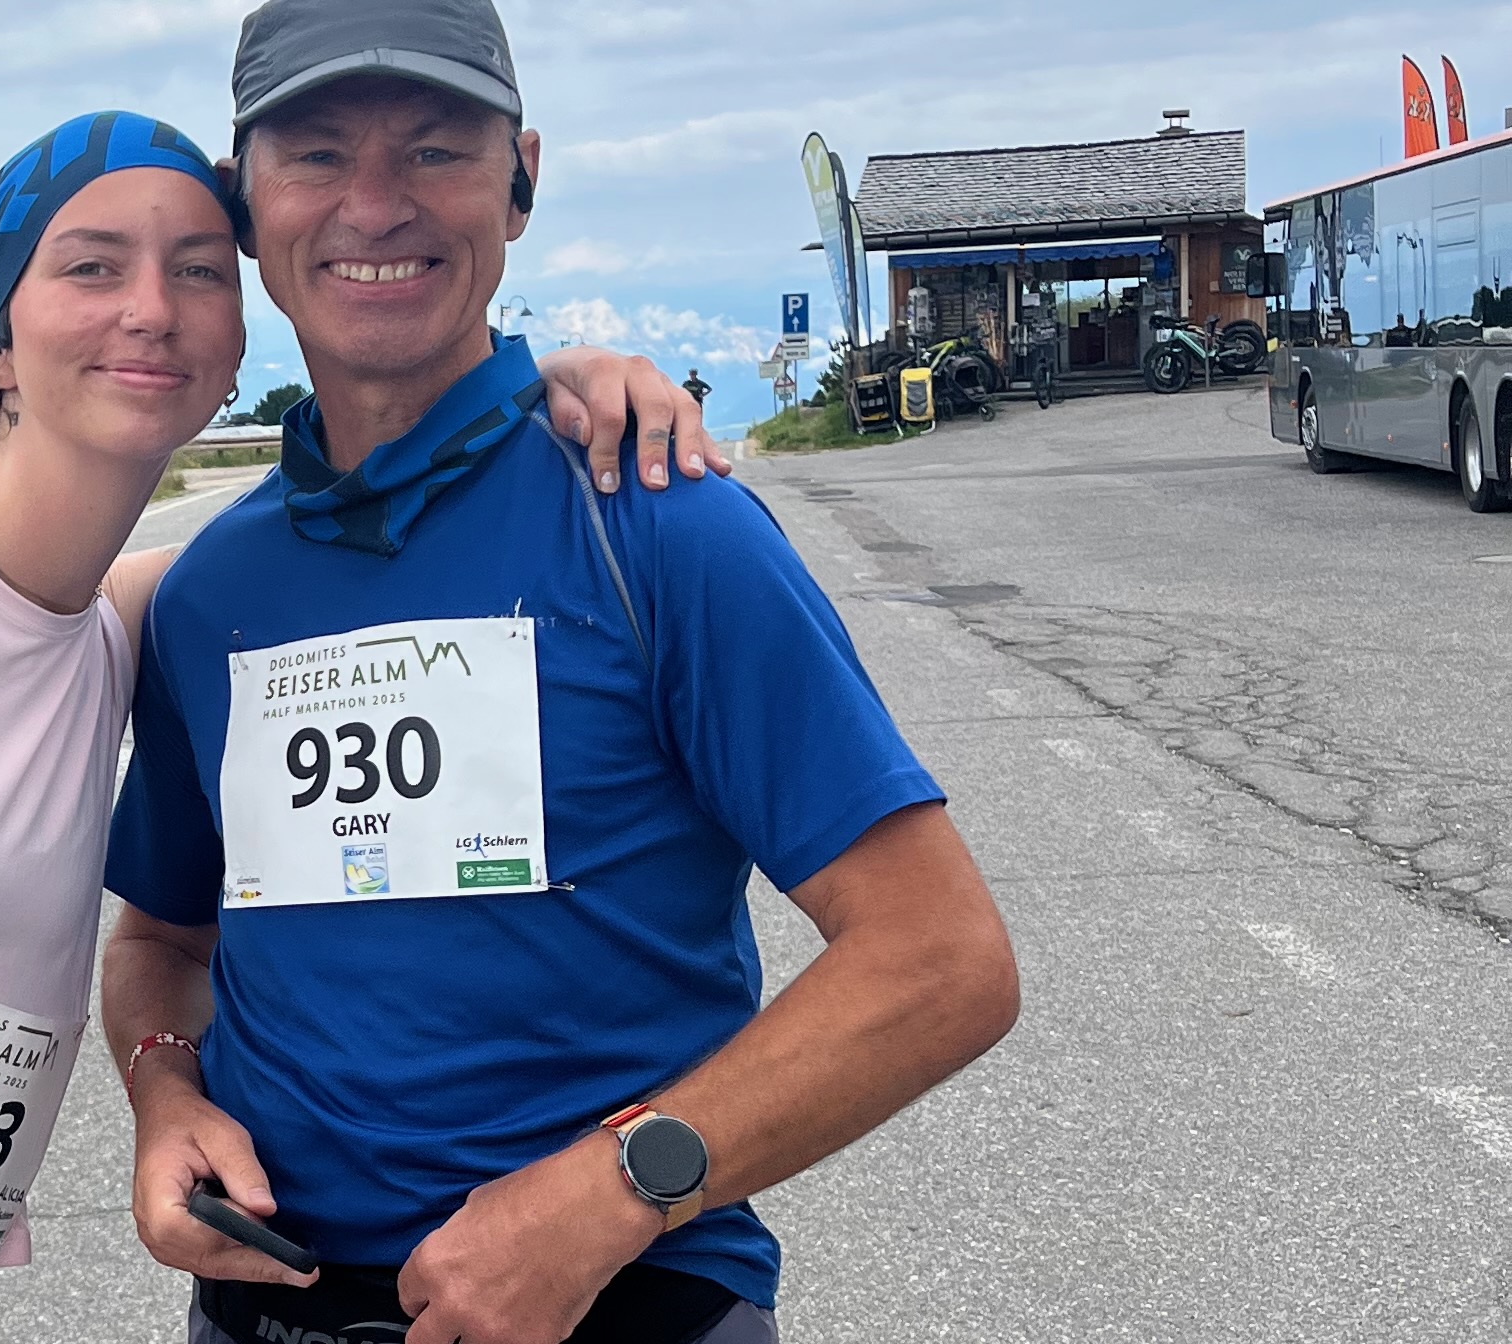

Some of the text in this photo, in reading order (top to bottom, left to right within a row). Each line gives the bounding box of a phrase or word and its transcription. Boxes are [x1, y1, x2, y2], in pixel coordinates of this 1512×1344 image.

[788, 296, 803, 316] P
[269, 645, 347, 672] DOLOMITES
[265, 659, 407, 701] SEISER ALM
[262, 692, 406, 720] HALF MARATHON 2025
[285, 716, 442, 810] 930
[331, 812, 391, 837] GARY
[455, 835, 529, 849] LG Schlern
[3, 1075, 29, 1089] 2025
